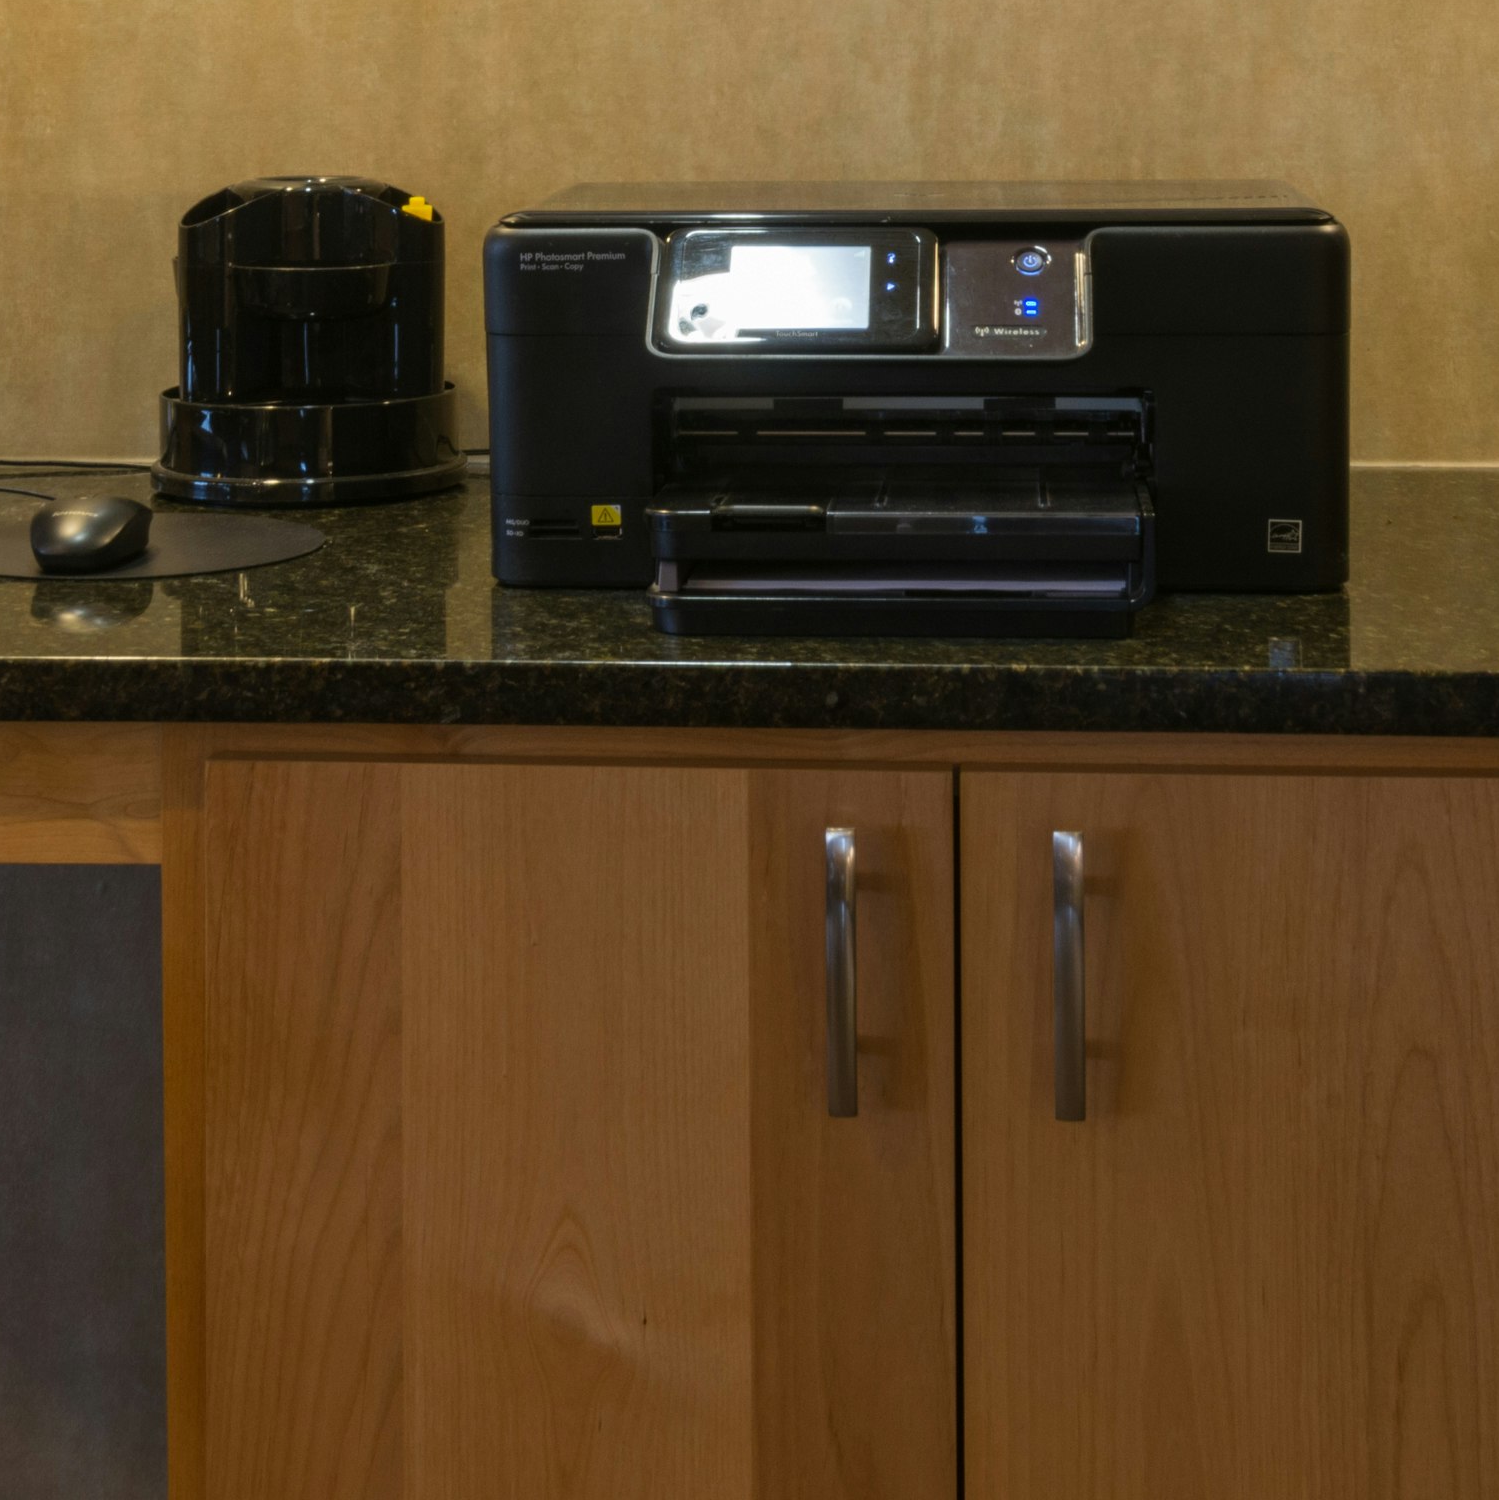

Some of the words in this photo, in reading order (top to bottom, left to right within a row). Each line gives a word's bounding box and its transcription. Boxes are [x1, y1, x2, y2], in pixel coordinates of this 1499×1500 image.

[520, 253, 533, 262] HP
[535, 252, 585, 261] Photosmart
[587, 252, 626, 260] Premium
[564, 263, 584, 271] Copy
[776, 330, 819, 338] TouchSmart
